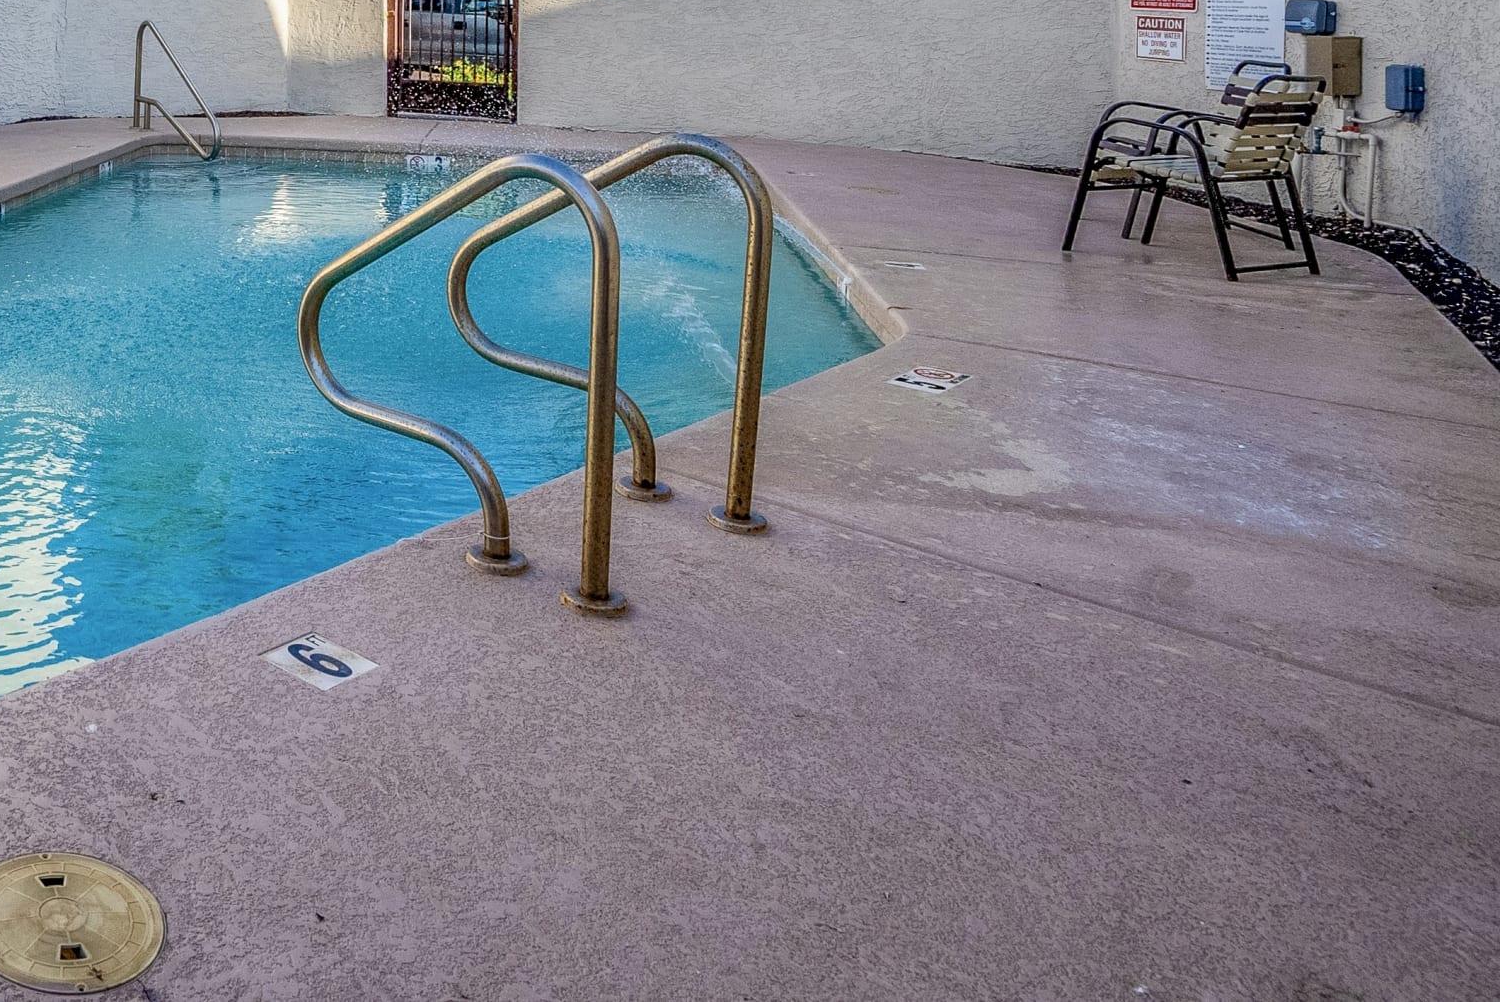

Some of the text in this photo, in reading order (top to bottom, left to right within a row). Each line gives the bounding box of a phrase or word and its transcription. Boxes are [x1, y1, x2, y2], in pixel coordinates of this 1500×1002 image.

[1138, 18, 1182, 29] CAUTION
[1139, 31, 1161, 39] SHALLOW
[287, 634, 353, 678] 6 FT
